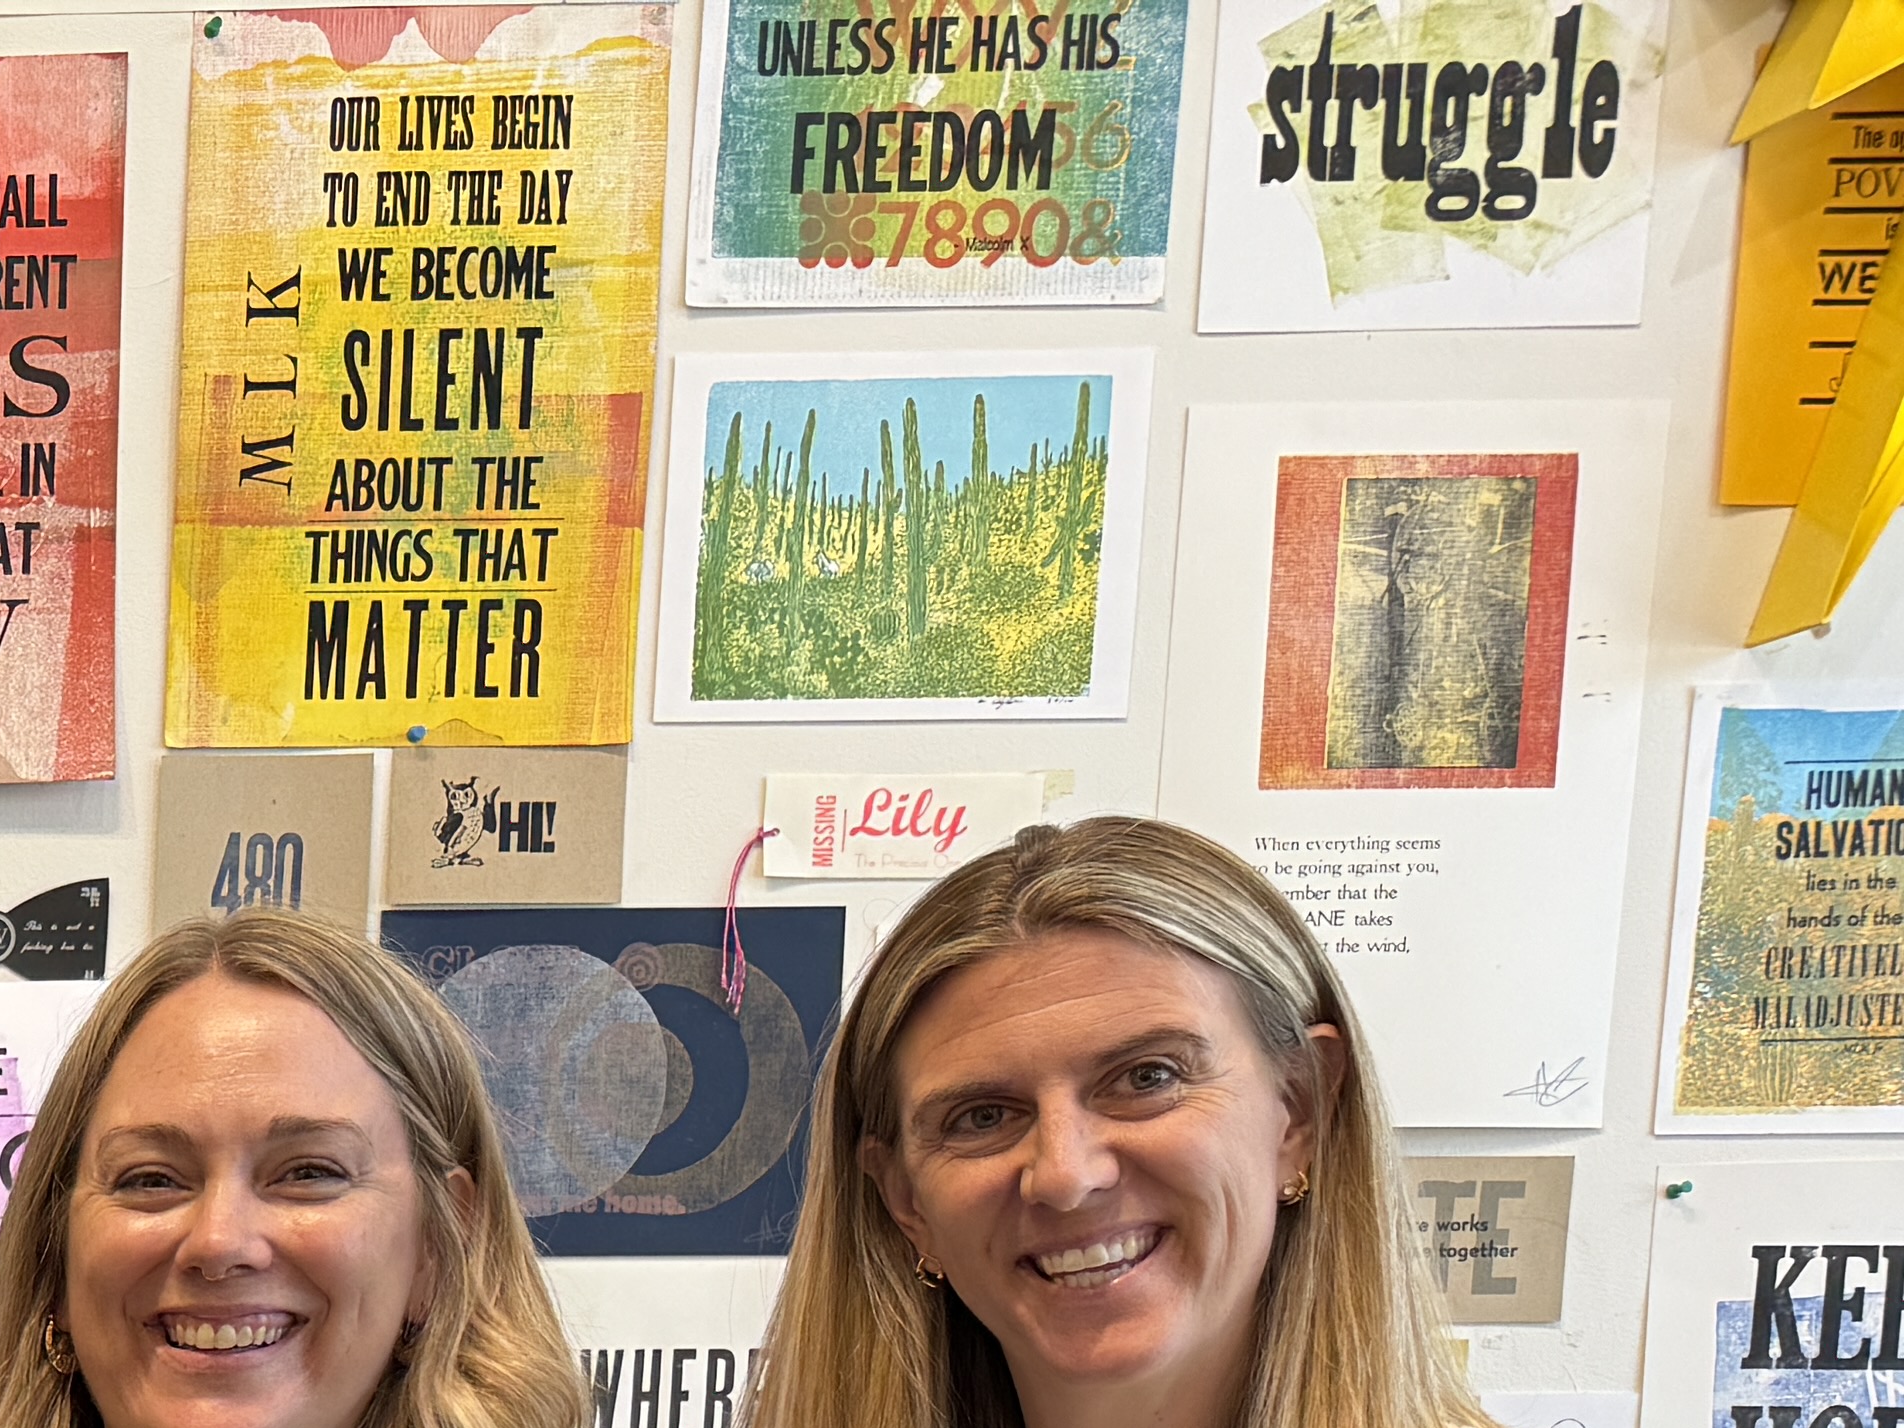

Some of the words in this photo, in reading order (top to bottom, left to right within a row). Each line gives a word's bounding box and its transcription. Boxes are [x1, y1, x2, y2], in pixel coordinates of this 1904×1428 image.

[758, 19, 895, 76] UNLESS
[909, 17, 962, 74] HE
[971, 14, 1049, 71] HAS
[1061, 13, 1121, 70] HIS
[1259, 5, 1621, 221] struggle
[791, 109, 1056, 194] FREEDOM
[239, 264, 304, 492] MLK
[340, 328, 545, 434] SILENT
[304, 598, 545, 702] MATTER
[499, 802, 556, 852] HI!
[815, 795, 837, 868] MISSING
[850, 786, 968, 853] Lily
[1255, 837, 1299, 851] When
[1306, 836, 1390, 853] everything
[1395, 839, 1440, 850] seems
[1806, 870, 1837, 891] lies
[1843, 874, 1860, 891] in
[1867, 870, 1897, 890] the
[1437, 1214, 1488, 1231] works
[1439, 1240, 1518, 1261] together
